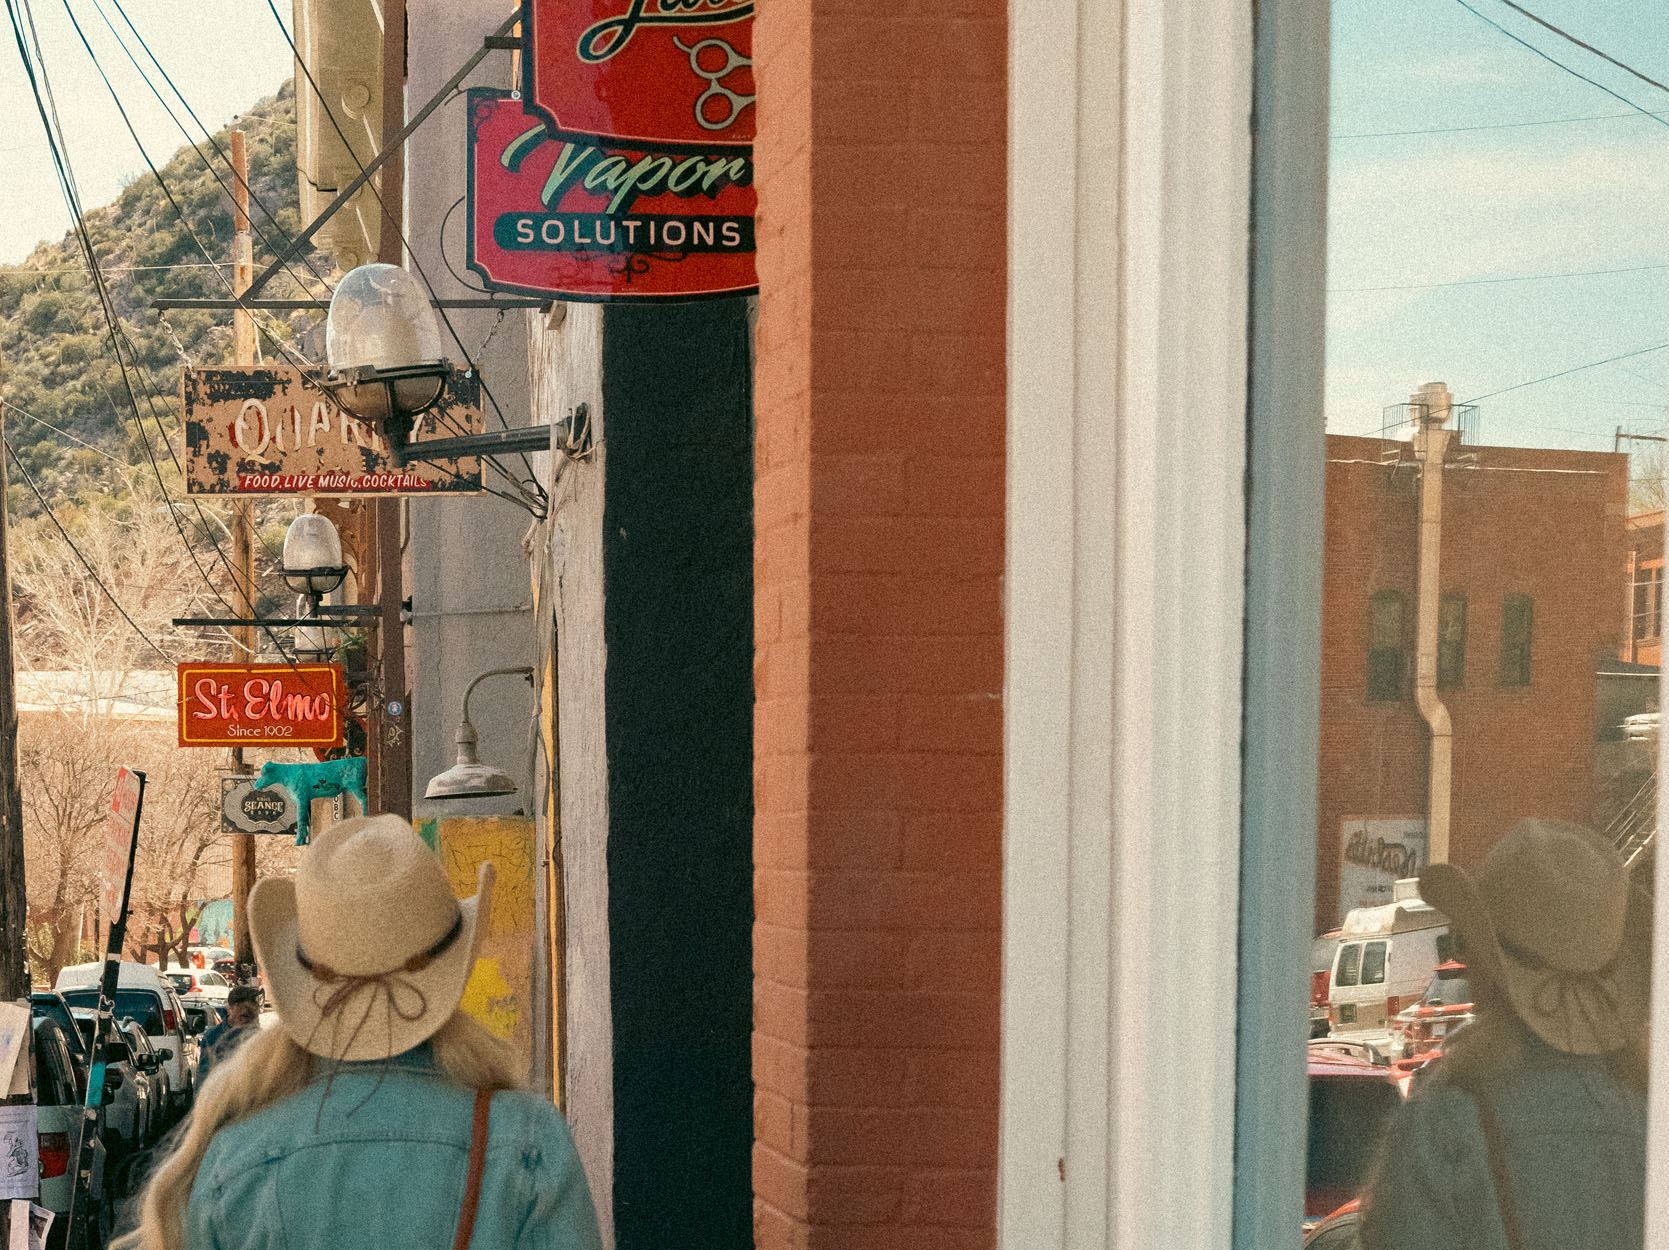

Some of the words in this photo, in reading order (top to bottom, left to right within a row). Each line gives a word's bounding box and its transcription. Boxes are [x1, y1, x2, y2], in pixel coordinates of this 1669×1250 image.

[501, 123, 745, 214] Vapor
[516, 219, 742, 246] SOLUTIONS
[284, 475, 316, 488] LIVE
[244, 678, 330, 721] Elmo
[227, 724, 261, 737] Since
[263, 725, 293, 737] 1902
